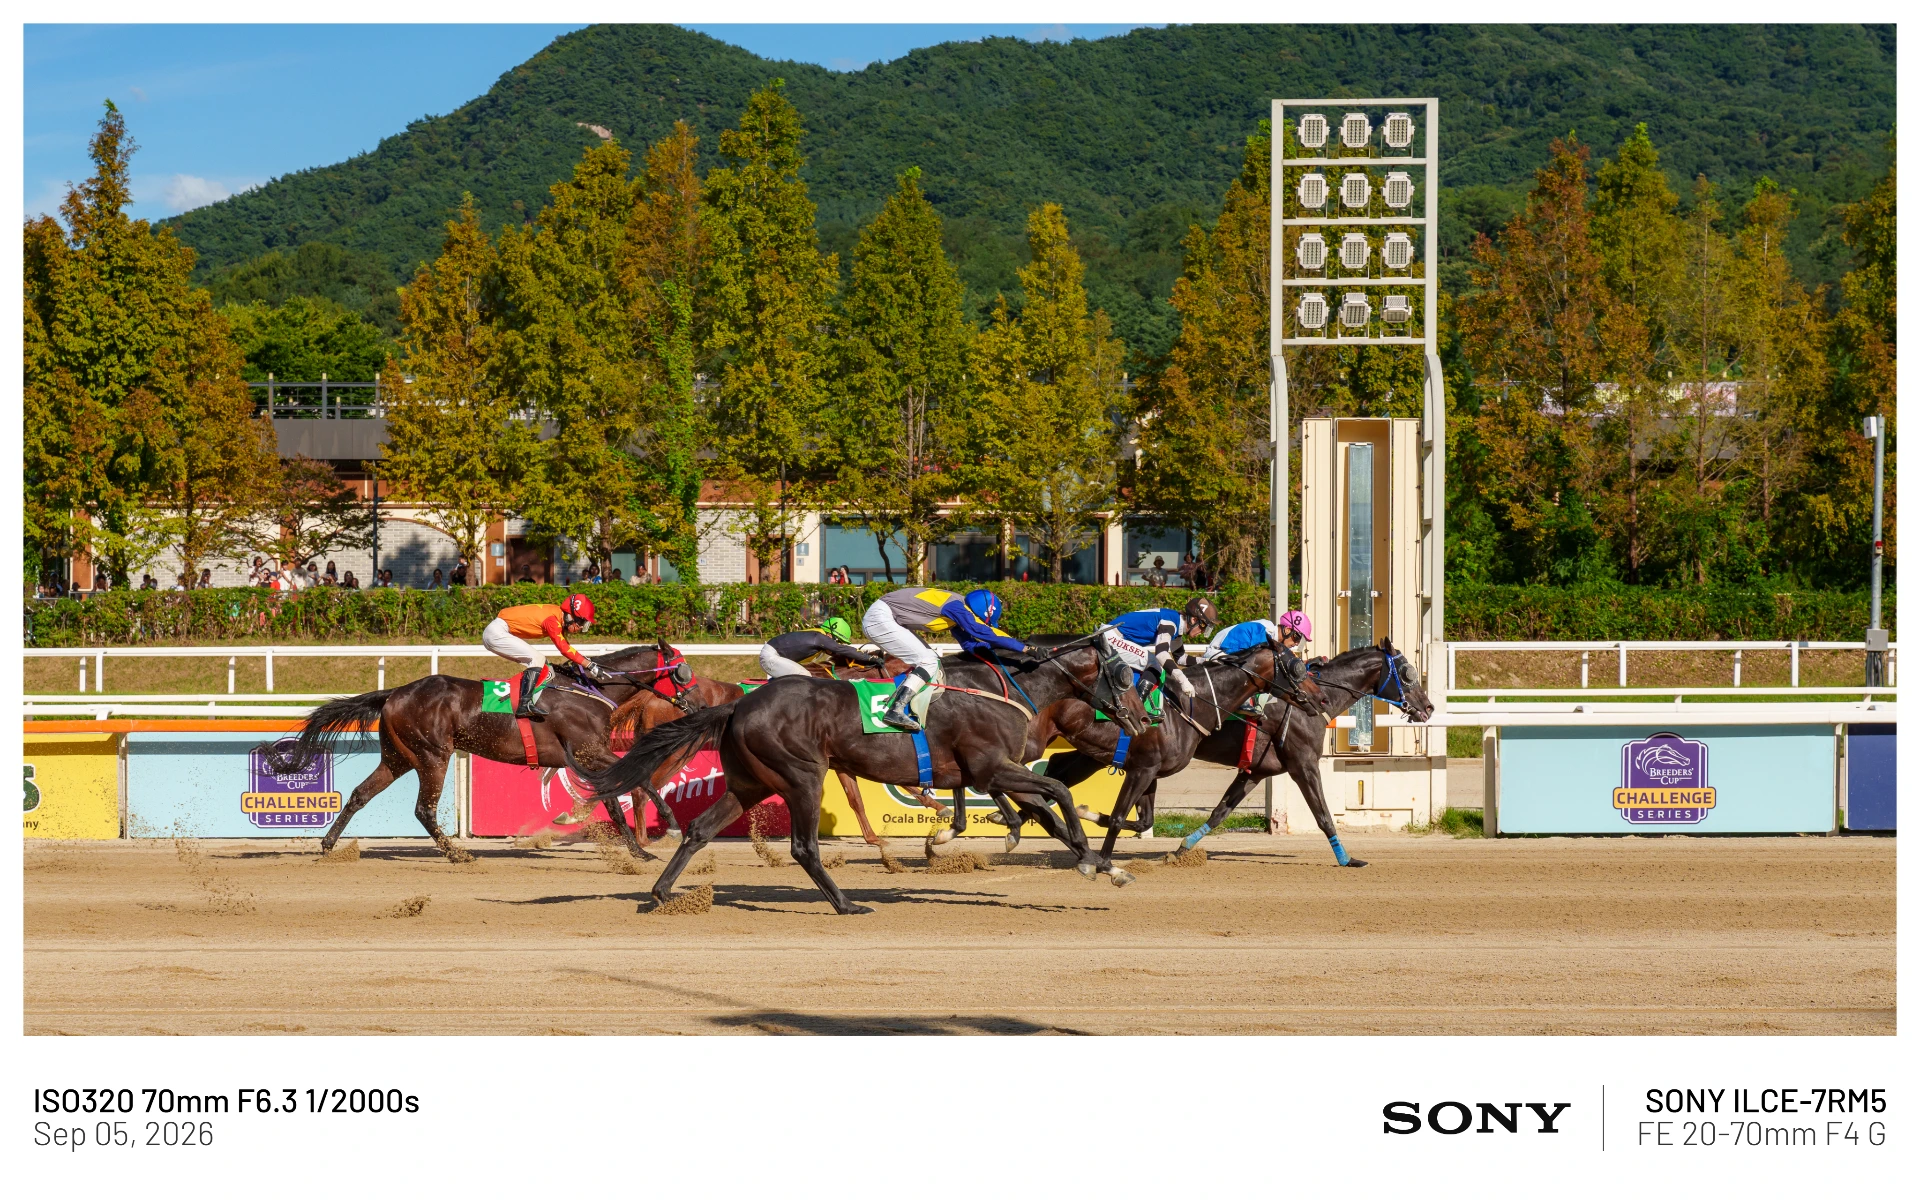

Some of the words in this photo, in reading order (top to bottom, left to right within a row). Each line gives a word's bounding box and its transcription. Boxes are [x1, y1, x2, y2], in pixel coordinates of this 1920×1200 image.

[573, 600, 582, 611] 3
[1200, 603, 1208, 612] 7
[831, 621, 838, 630] 6
[1294, 615, 1302, 626] 8
[493, 681, 511, 697] 3
[871, 694, 891, 728] 5
[1650, 767, 1694, 777] BREEDERS'
[286, 780, 307, 790] CUP
[1660, 775, 1680, 785] CUP
[245, 796, 338, 809] CHALLENGE
[1617, 792, 1712, 804] CHALLENGE
[265, 814, 318, 823] SERIES
[882, 813, 914, 824] Ocala
[1637, 810, 1692, 819] SERIES
